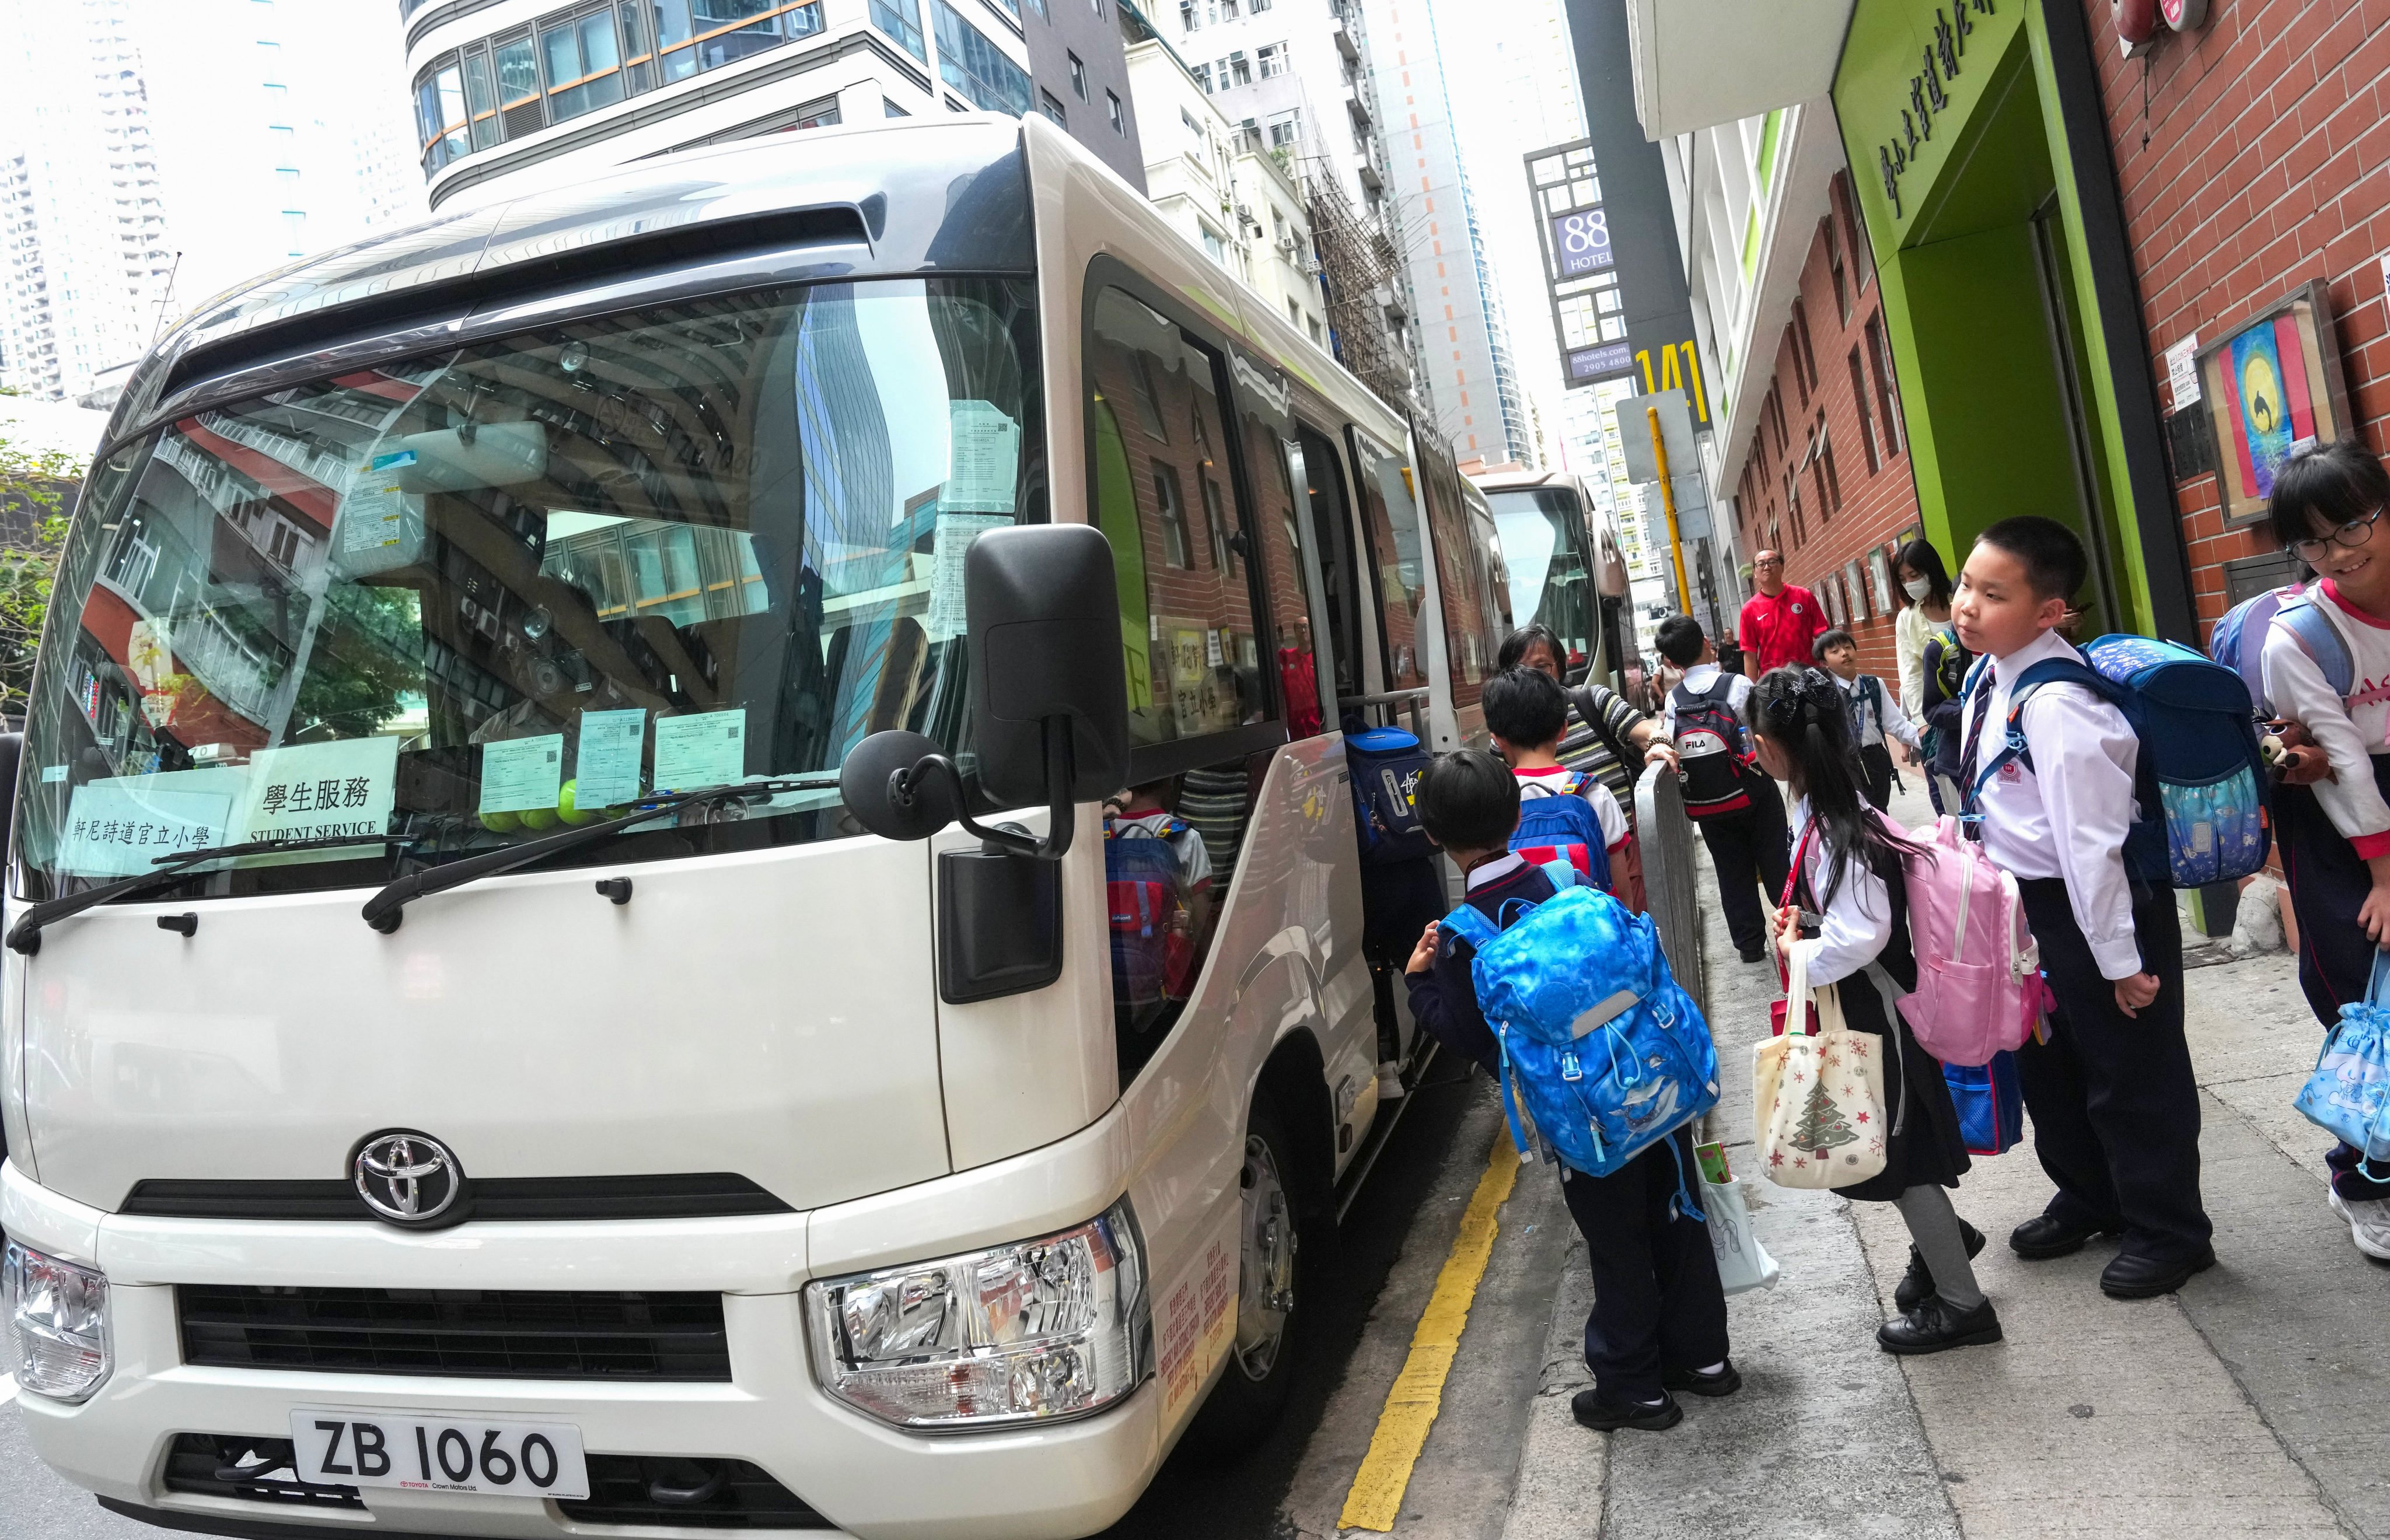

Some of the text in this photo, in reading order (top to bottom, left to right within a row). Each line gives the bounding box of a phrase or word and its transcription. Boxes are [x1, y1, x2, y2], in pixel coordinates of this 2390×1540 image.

[1565, 211, 1610, 253] 88
[1570, 251, 1613, 270] HOTEL
[1584, 356, 1631, 372] 2905 4800
[1635, 340, 1707, 422] 141
[1685, 740, 1706, 750] FILA
[263, 776, 371, 816] 學生服務
[72, 817, 209, 850] 軒尼詩道官立小學
[250, 821, 376, 844] STUDENT SERVICE
[315, 1420, 558, 1488] ZB 1060
